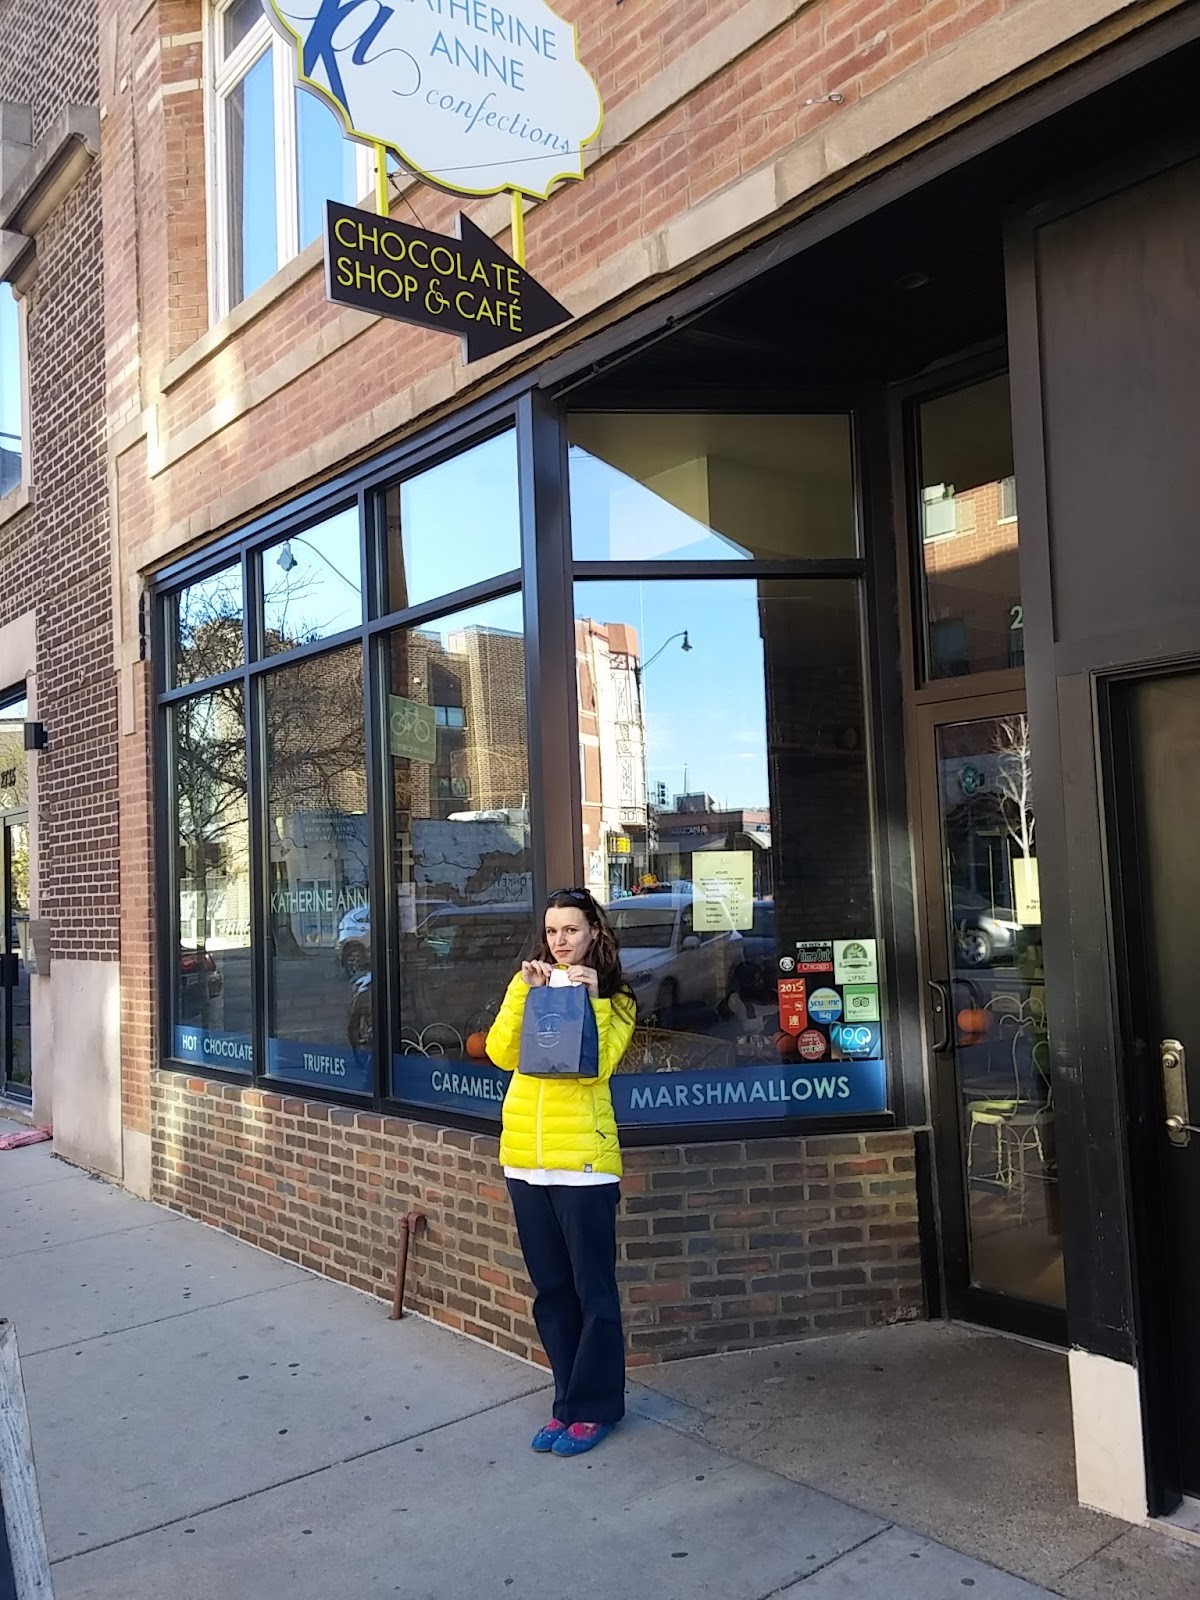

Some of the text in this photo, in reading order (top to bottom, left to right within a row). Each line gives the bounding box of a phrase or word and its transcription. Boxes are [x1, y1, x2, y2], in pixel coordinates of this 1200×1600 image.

[429, 30, 525, 92] ANNE
[426, 90, 570, 153] confections
[334, 218, 521, 297] CHOCOLATE
[336, 257, 523, 333] SHOP & CAFÉ
[270, 886, 370, 914] KATHERINE ANN
[802, 963, 830, 972] Chicago
[780, 980, 804, 993] 2015
[182, 1035, 253, 1062] HOT CHOCOLATE
[303, 1053, 346, 1077] TRUFFLES
[431, 1070, 504, 1102] CARAMELS
[630, 1076, 850, 1110] MARSHMALLOWS
